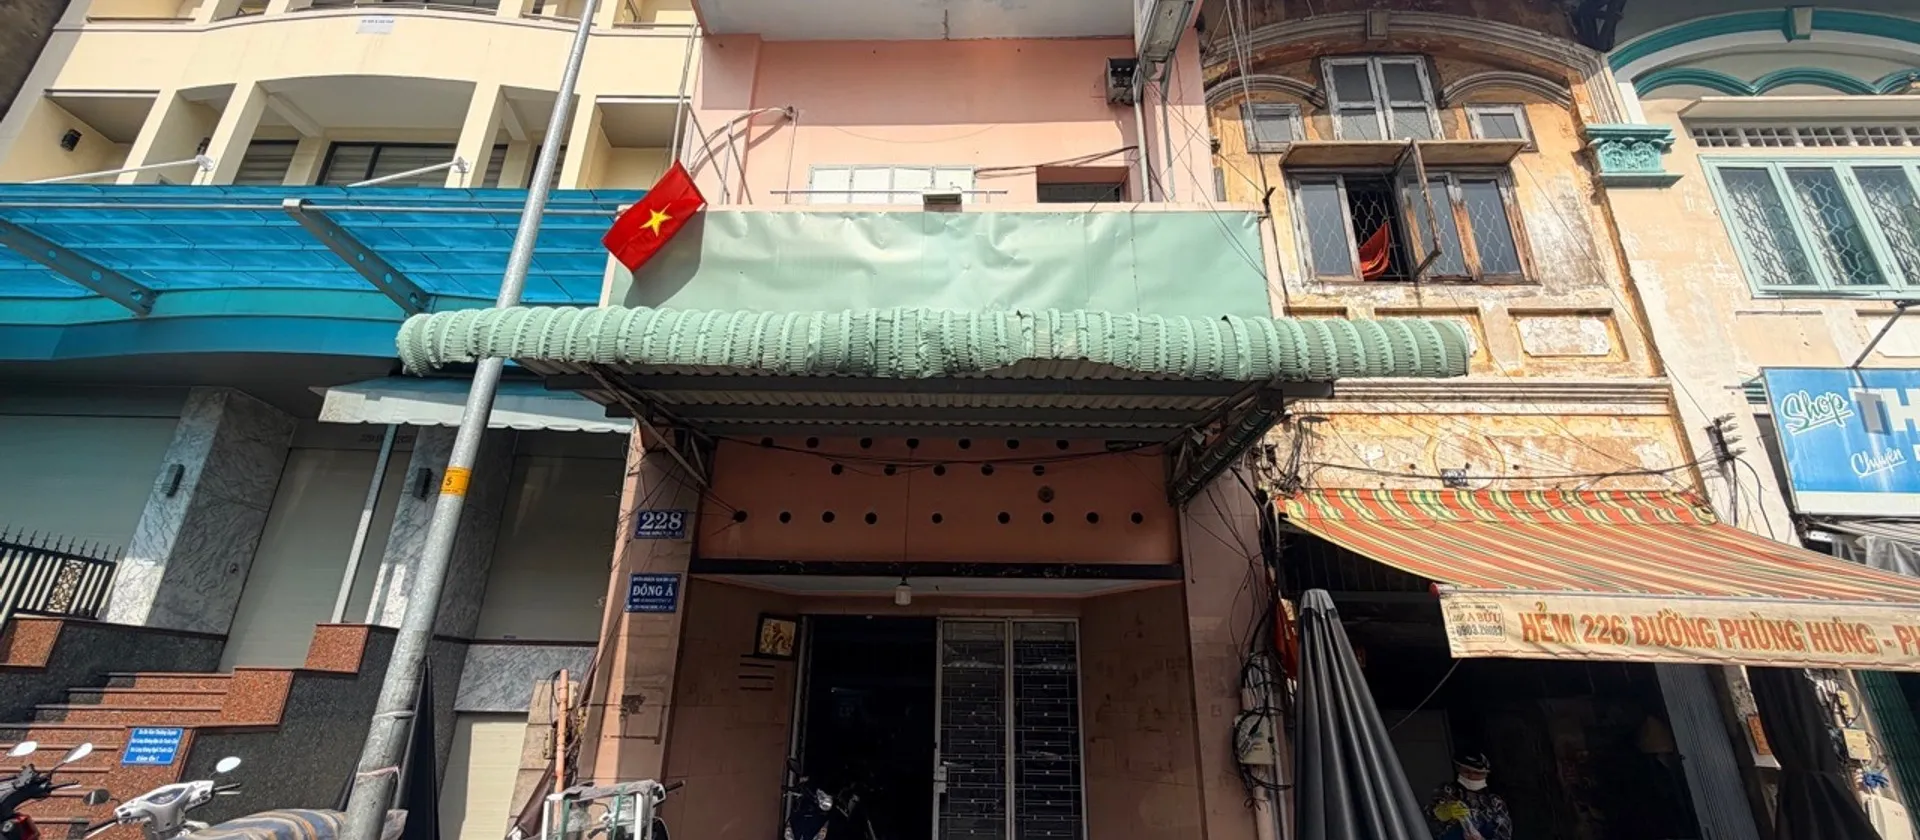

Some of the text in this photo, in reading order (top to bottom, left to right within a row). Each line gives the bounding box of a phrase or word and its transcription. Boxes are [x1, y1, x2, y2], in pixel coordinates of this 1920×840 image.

[1781, 390, 1854, 435] Shop
[640, 511, 682, 530] 228
[1519, 602, 1577, 643] HẺM
[1579, 614, 1630, 645] 226
[1631, 608, 1720, 649] ĐƯỜNG
[1718, 611, 1807, 652] PHÙNG
[1806, 616, 1881, 656] HƯNG
